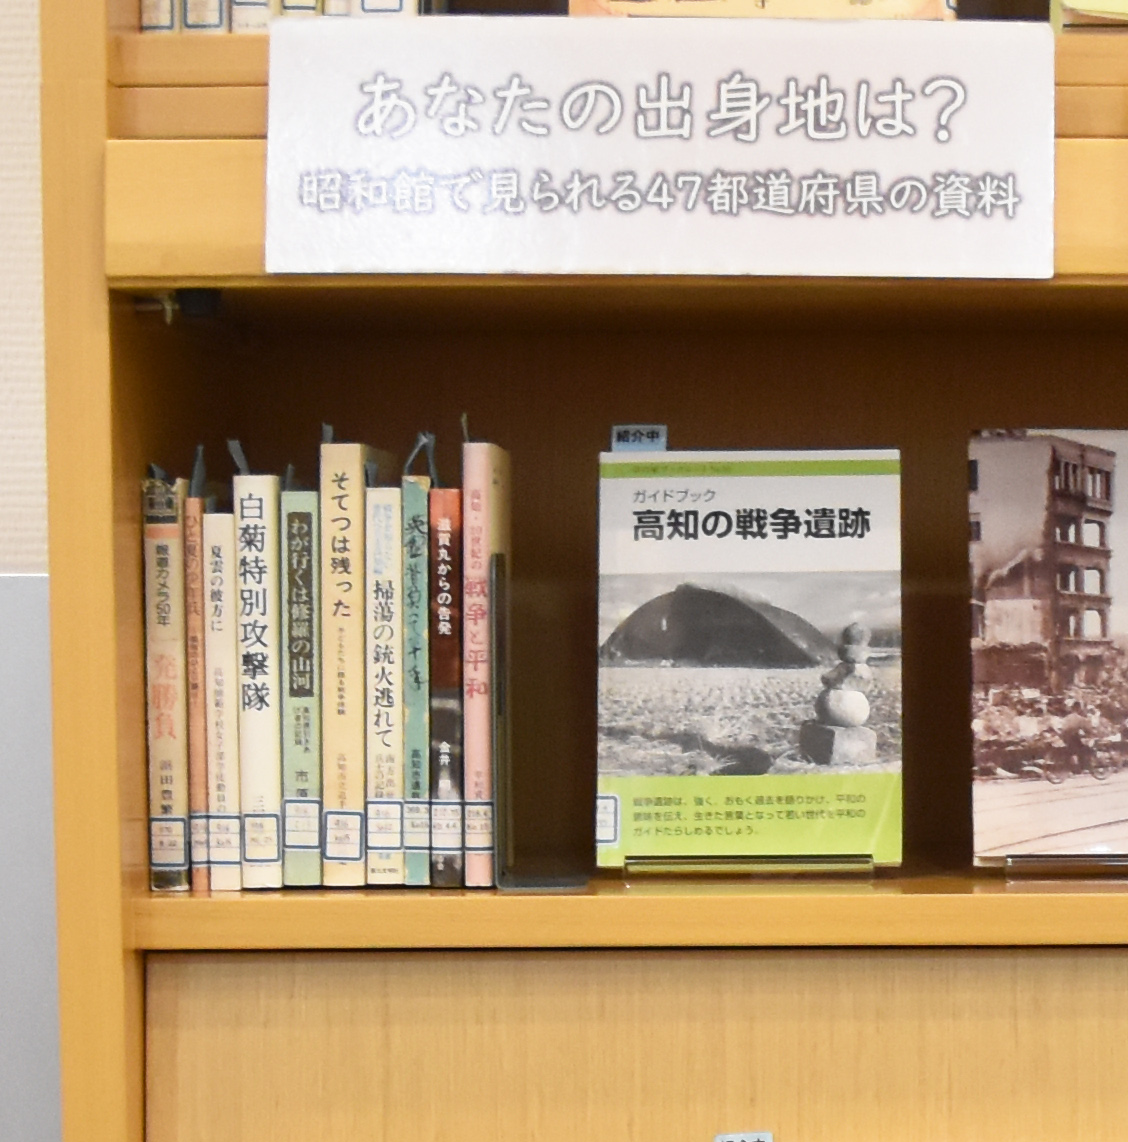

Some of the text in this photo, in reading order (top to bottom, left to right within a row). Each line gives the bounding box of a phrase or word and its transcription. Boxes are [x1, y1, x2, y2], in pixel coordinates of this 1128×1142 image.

[356, 73, 967, 143] あなたの出身地は？
[301, 170, 1020, 218] 昭和館で見られる47都道府県の資料
[615, 429, 661, 444] 紹介中
[632, 488, 717, 504] ガイドブック
[330, 472, 352, 618] そてつは残った
[632, 506, 872, 542] 高知の戦争遺跡
[239, 492, 270, 712] 白菊特別攻撃隊
